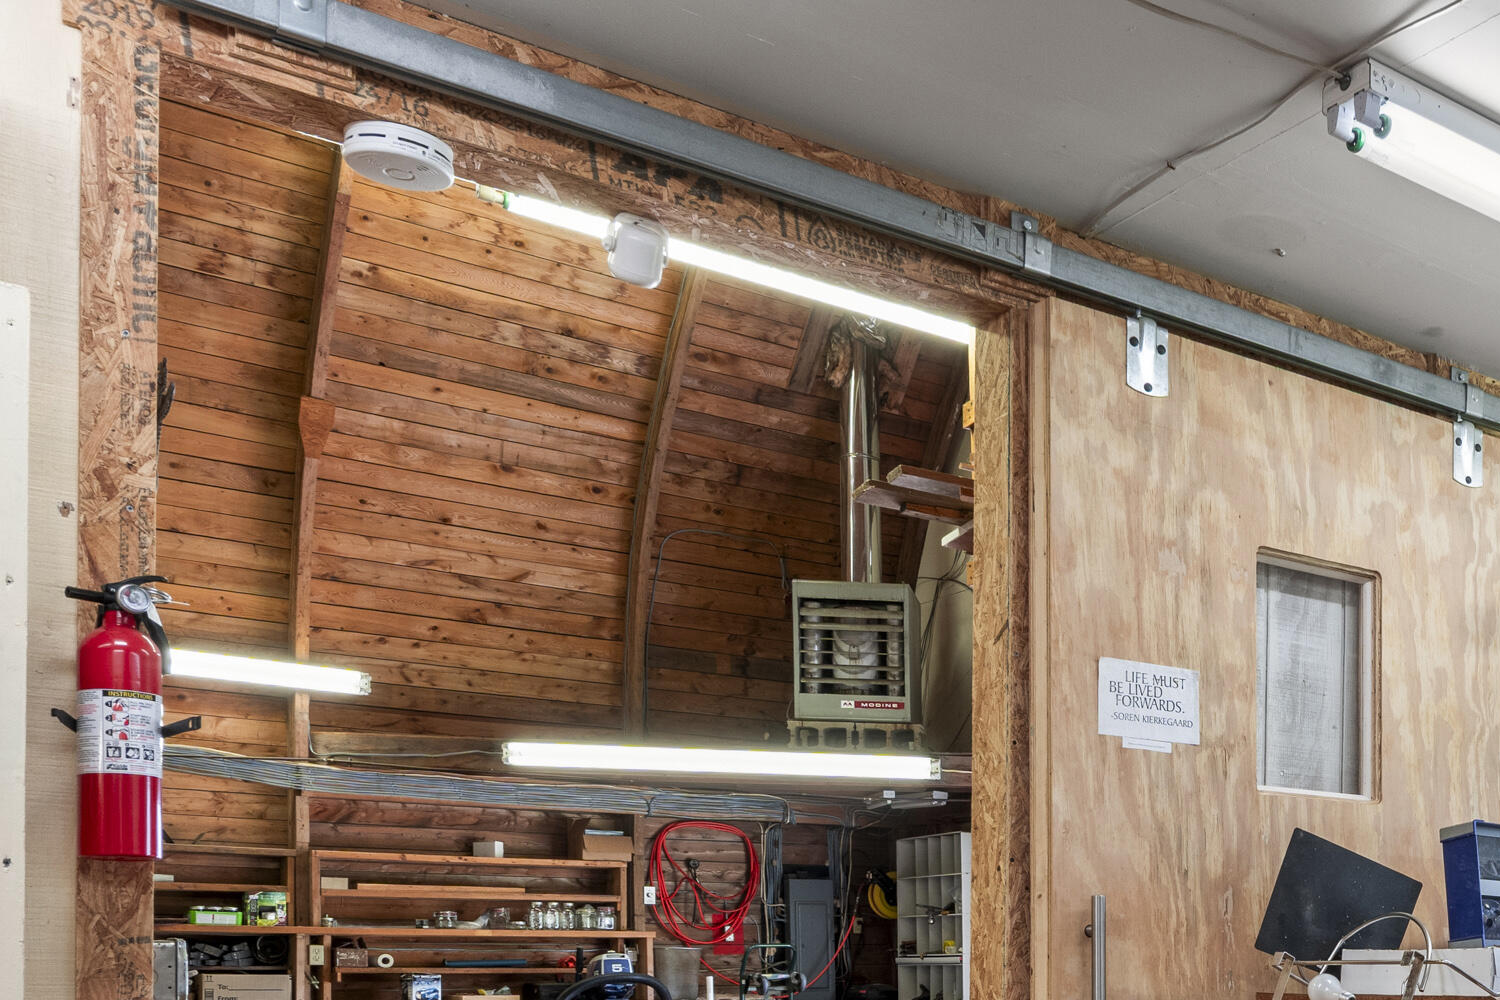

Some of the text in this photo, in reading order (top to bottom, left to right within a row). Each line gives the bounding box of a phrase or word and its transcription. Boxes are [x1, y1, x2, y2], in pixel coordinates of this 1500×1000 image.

[1125, 670, 1186, 690] LIFE MUST
[107, 689, 153, 701] INSTRUCTIONS
[1109, 681, 1163, 698] BE LIVED
[1115, 694, 1185, 713] FORWARDS.
[1142, 715, 1193, 728] KIERKEGAARD
[611, 963, 623, 973] 5
